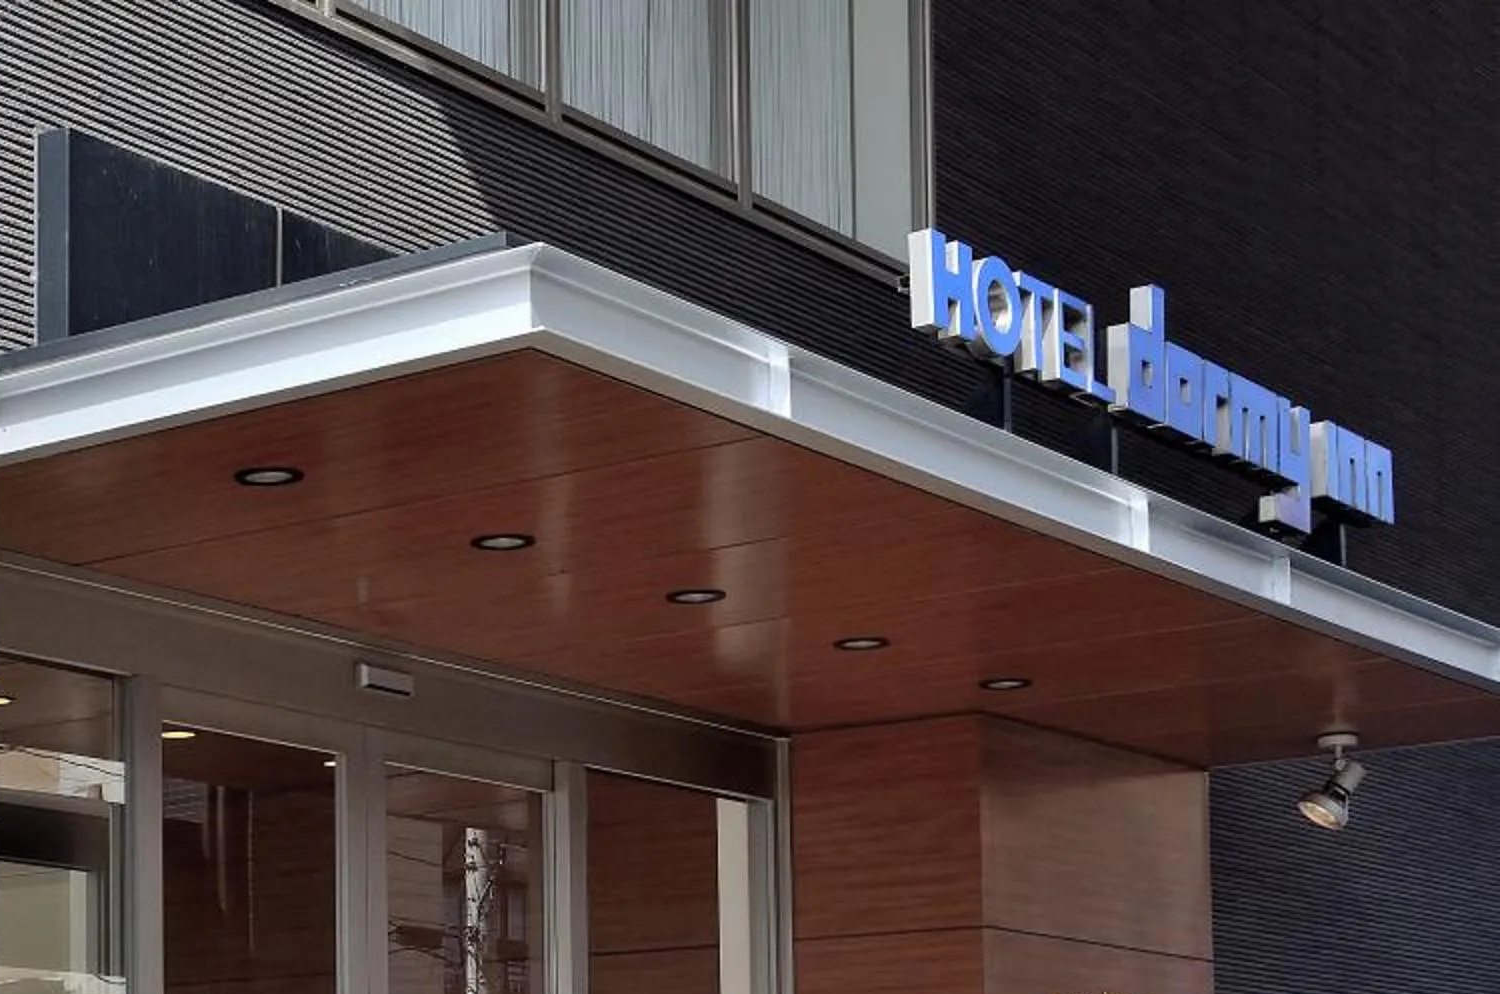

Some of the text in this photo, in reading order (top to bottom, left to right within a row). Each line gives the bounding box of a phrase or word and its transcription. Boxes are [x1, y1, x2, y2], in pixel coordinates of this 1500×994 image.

[908, 228, 1394, 534] HOTEL dormy inn
